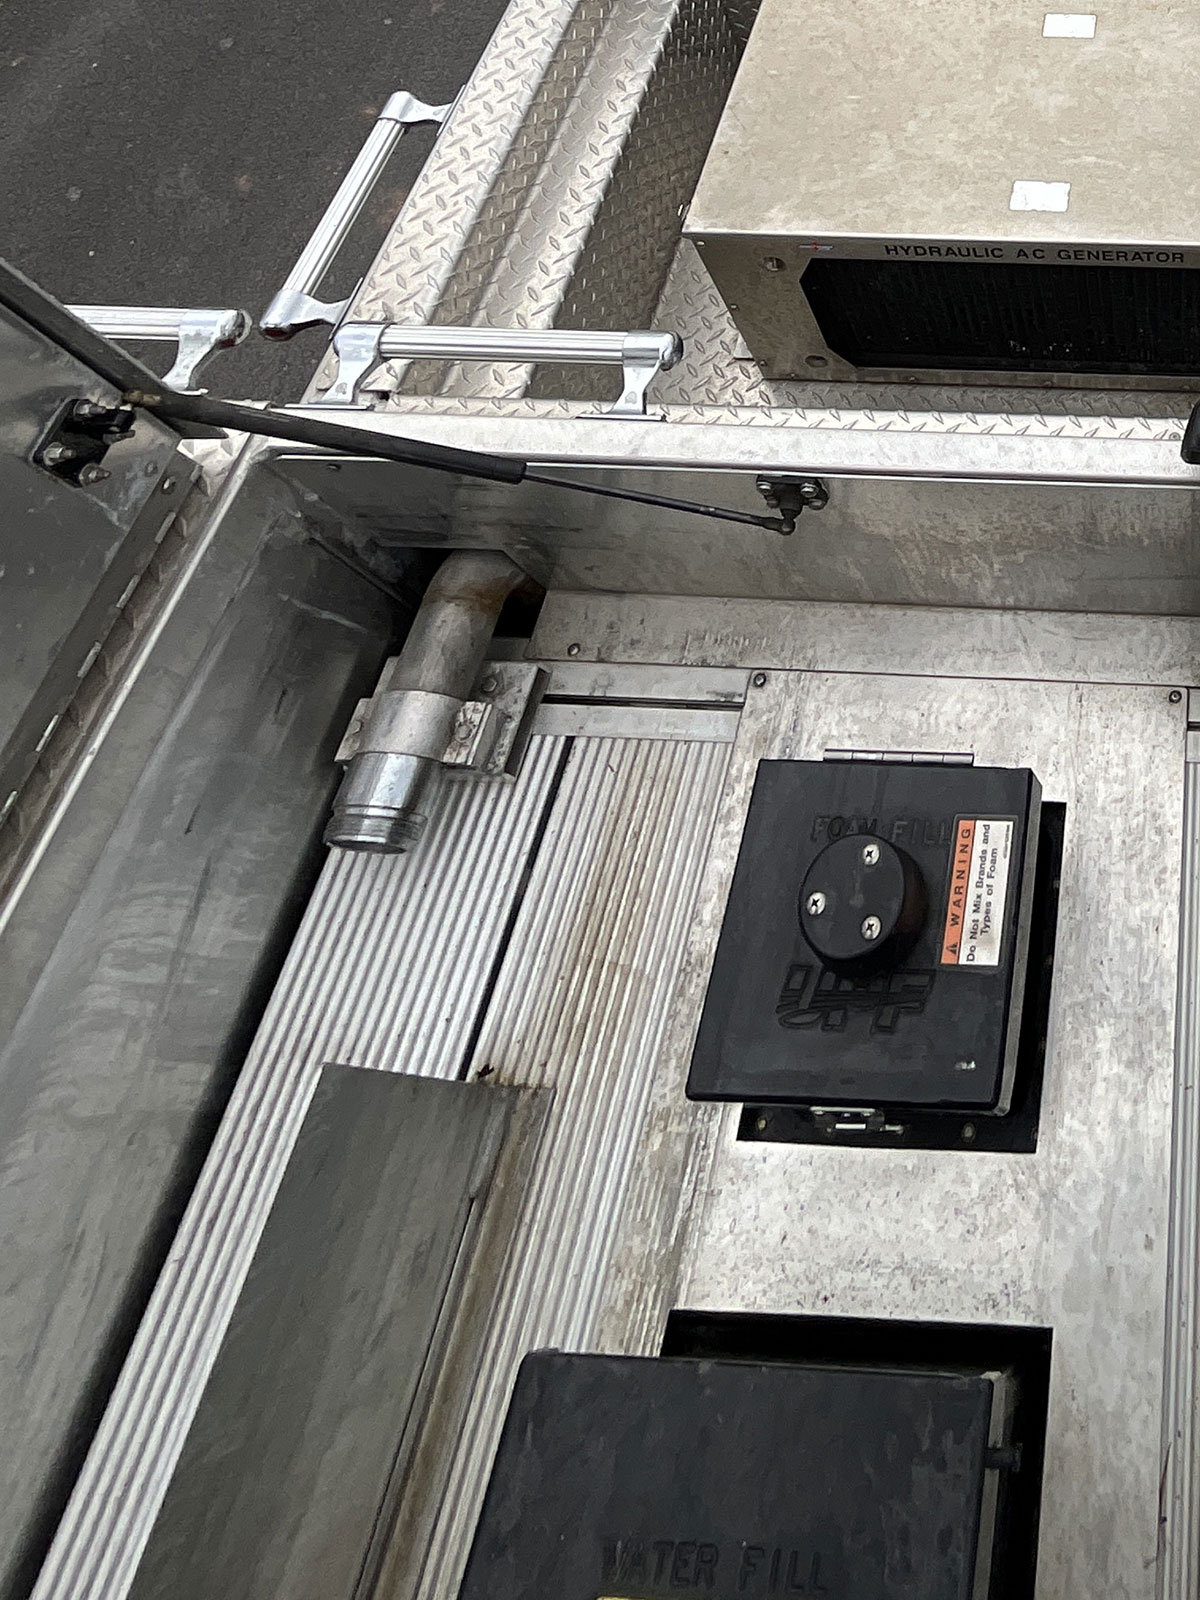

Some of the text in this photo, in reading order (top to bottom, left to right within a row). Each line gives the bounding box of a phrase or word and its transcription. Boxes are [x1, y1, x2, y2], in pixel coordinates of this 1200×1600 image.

[884, 244, 1185, 264] HYDRAULIC AC GENERATOR
[950, 828, 971, 927] WARNING
[966, 824, 991, 962] Do Not Mix Brands and
[980, 847, 998, 936] Types of Foam
[602, 1539, 828, 1594] WATER FILL
